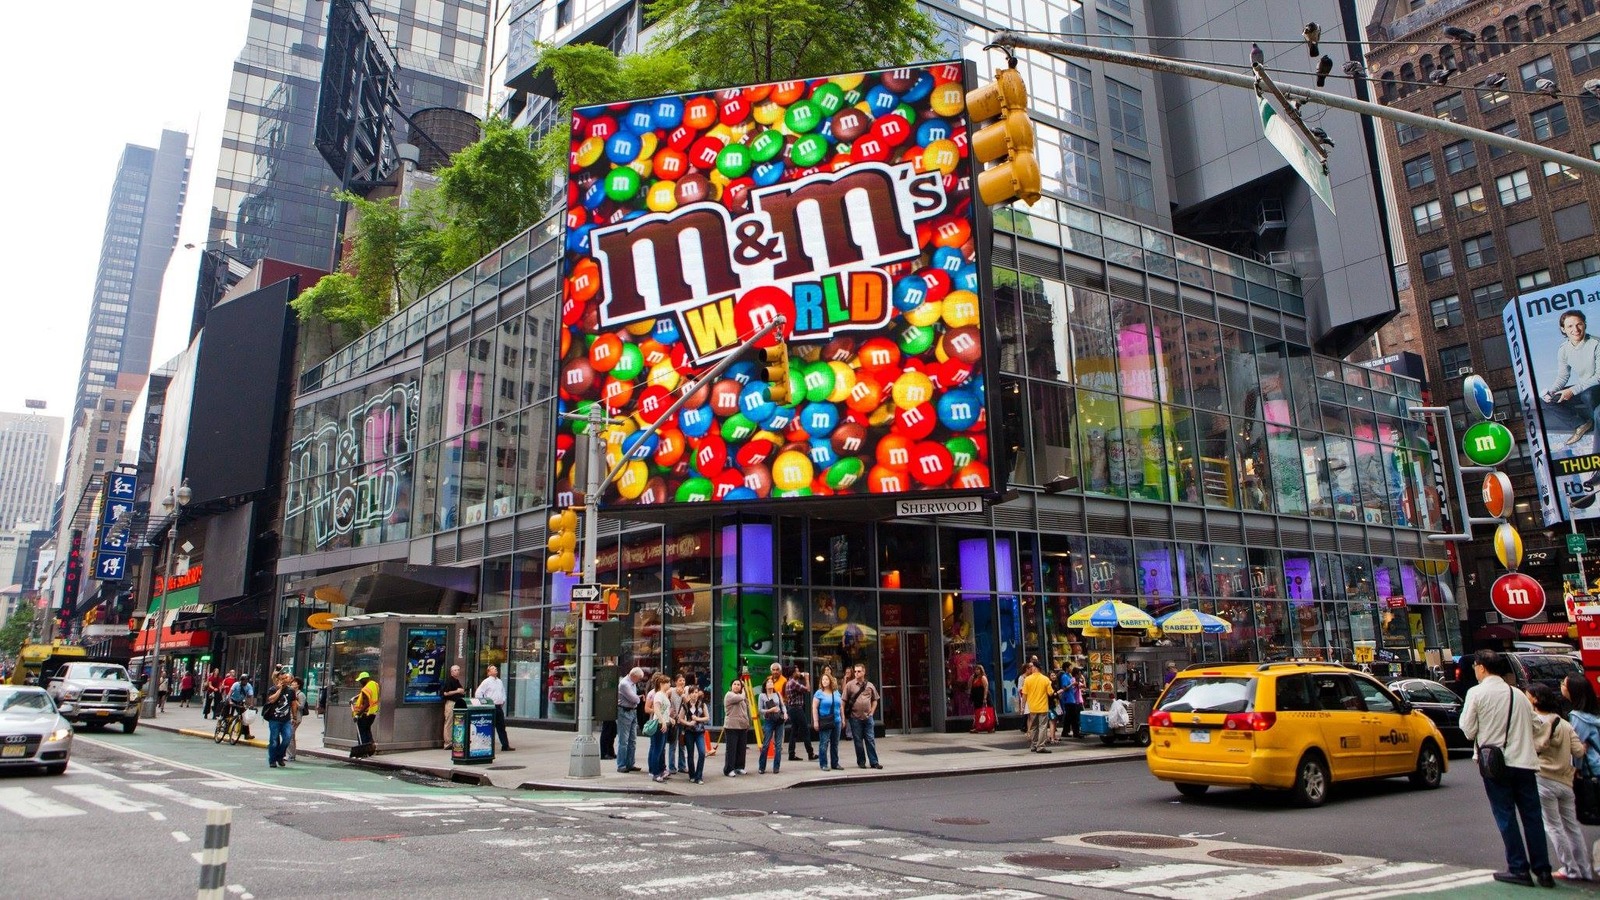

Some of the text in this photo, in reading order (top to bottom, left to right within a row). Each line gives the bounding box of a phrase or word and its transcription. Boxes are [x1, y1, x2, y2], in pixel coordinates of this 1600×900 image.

[942, 65, 958, 81] m
[820, 93, 839, 110] m
[844, 90, 861, 105] m
[876, 93, 894, 108] m
[944, 91, 960, 103] m
[658, 103, 675, 117] m
[691, 105, 707, 119] m
[724, 101, 740, 115] m
[793, 105, 811, 120] m
[633, 113, 650, 127] m
[840, 114, 859, 131] m
[592, 123, 607, 137] m
[672, 127, 686, 142] m
[880, 121, 901, 137] m
[580, 142, 592, 155] m
[614, 140, 631, 155] m
[754, 134, 772, 152] m
[798, 139, 817, 155] m
[860, 140, 880, 157] m
[700, 147, 717, 163] m
[725, 152, 742, 167] m
[936, 150, 955, 165] m
[663, 157, 679, 171] m
[756, 163, 774, 177] m
[612, 176, 629, 191] m
[681, 181, 698, 197] m
[586, 184, 597, 200] m
[654, 189, 670, 203] m
[610, 209, 624, 224] m
[938, 222, 959, 239] m
[595, 165, 944, 321] m&m's
[943, 255, 961, 271] m
[575, 274, 589, 291] m
[903, 288, 923, 304] m
[1526, 288, 1585, 317] men
[563, 299, 574, 316] m
[955, 303, 975, 317] m
[657, 318, 673, 334] m
[902, 325, 921, 344] m
[951, 333, 975, 353] m
[594, 343, 610, 361] m
[646, 350, 664, 363] m
[833, 349, 850, 362] m
[872, 350, 890, 365] m
[615, 355, 632, 370] m
[567, 368, 583, 385] m
[735, 373, 750, 385] m
[804, 371, 824, 389] m
[952, 369, 970, 381] m
[606, 381, 622, 397] m
[850, 381, 870, 402] m
[906, 386, 925, 401] m
[1506, 313, 1524, 378] men
[1523, 393, 1543, 467] work
[643, 395, 659, 412] m
[718, 392, 736, 408] m
[745, 391, 764, 410] m
[683, 409, 700, 426] m
[902, 407, 924, 427] m
[950, 403, 971, 420] m
[770, 416, 788, 429] m
[811, 413, 830, 428] m
[610, 431, 626, 444] m
[731, 426, 750, 439] m
[658, 438, 673, 456] m
[842, 437, 861, 450] m
[1475, 435, 1496, 452] m
[699, 446, 714, 466] m
[748, 454, 766, 464] m
[810, 447, 830, 463] m
[889, 448, 909, 465] m
[954, 452, 970, 467] m
[919, 454, 943, 474] m
[1560, 455, 1600, 475] THUR
[621, 470, 636, 488] m
[745, 473, 762, 490] m
[782, 467, 803, 483] m
[838, 473, 857, 486] m
[961, 474, 985, 489] m
[880, 476, 901, 493] m
[1564, 477, 1594, 495] tbs
[558, 491, 574, 507] m
[641, 488, 655, 504] m
[900, 500, 977, 515] SHERWOOD
[1508, 587, 1530, 605] m
[418, 658, 436, 675] 22
